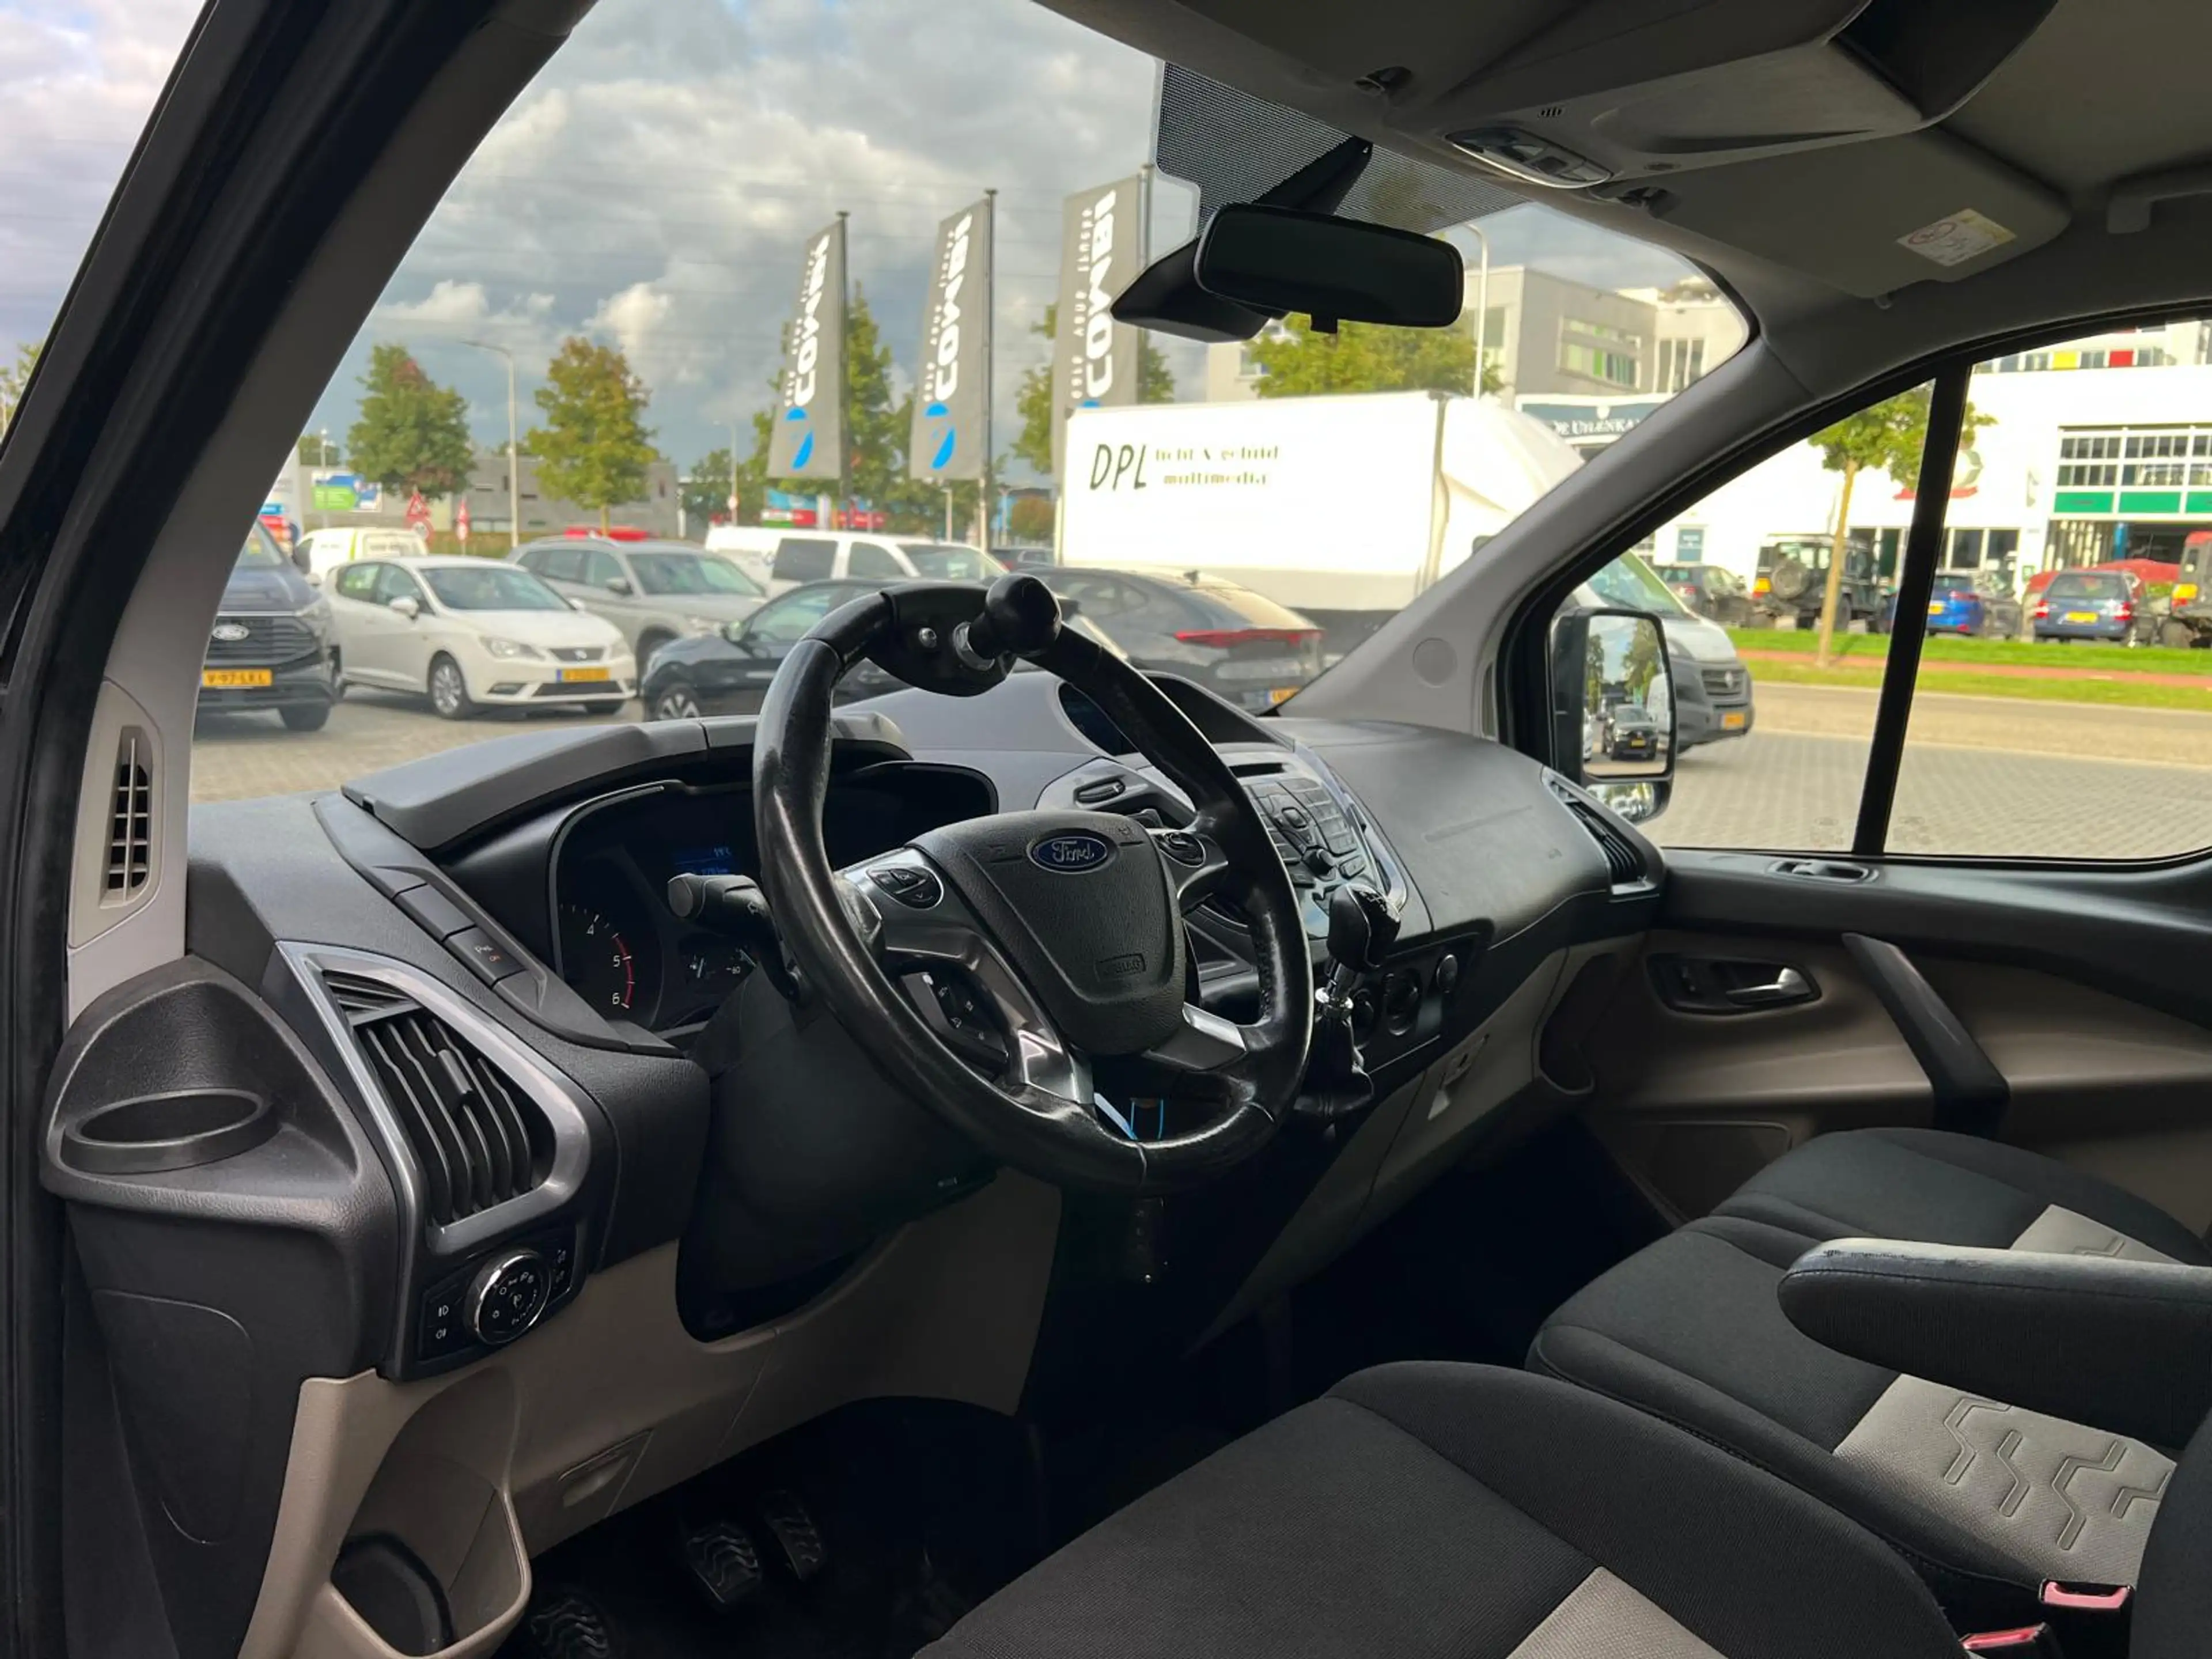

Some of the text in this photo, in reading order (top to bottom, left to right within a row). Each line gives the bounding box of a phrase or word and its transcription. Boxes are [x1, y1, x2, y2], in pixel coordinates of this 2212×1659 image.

[1089, 443, 1147, 491] DPL
[1051, 840, 1094, 863] Ford
[613, 955, 620, 968] 5
[612, 992, 620, 1005] 6
